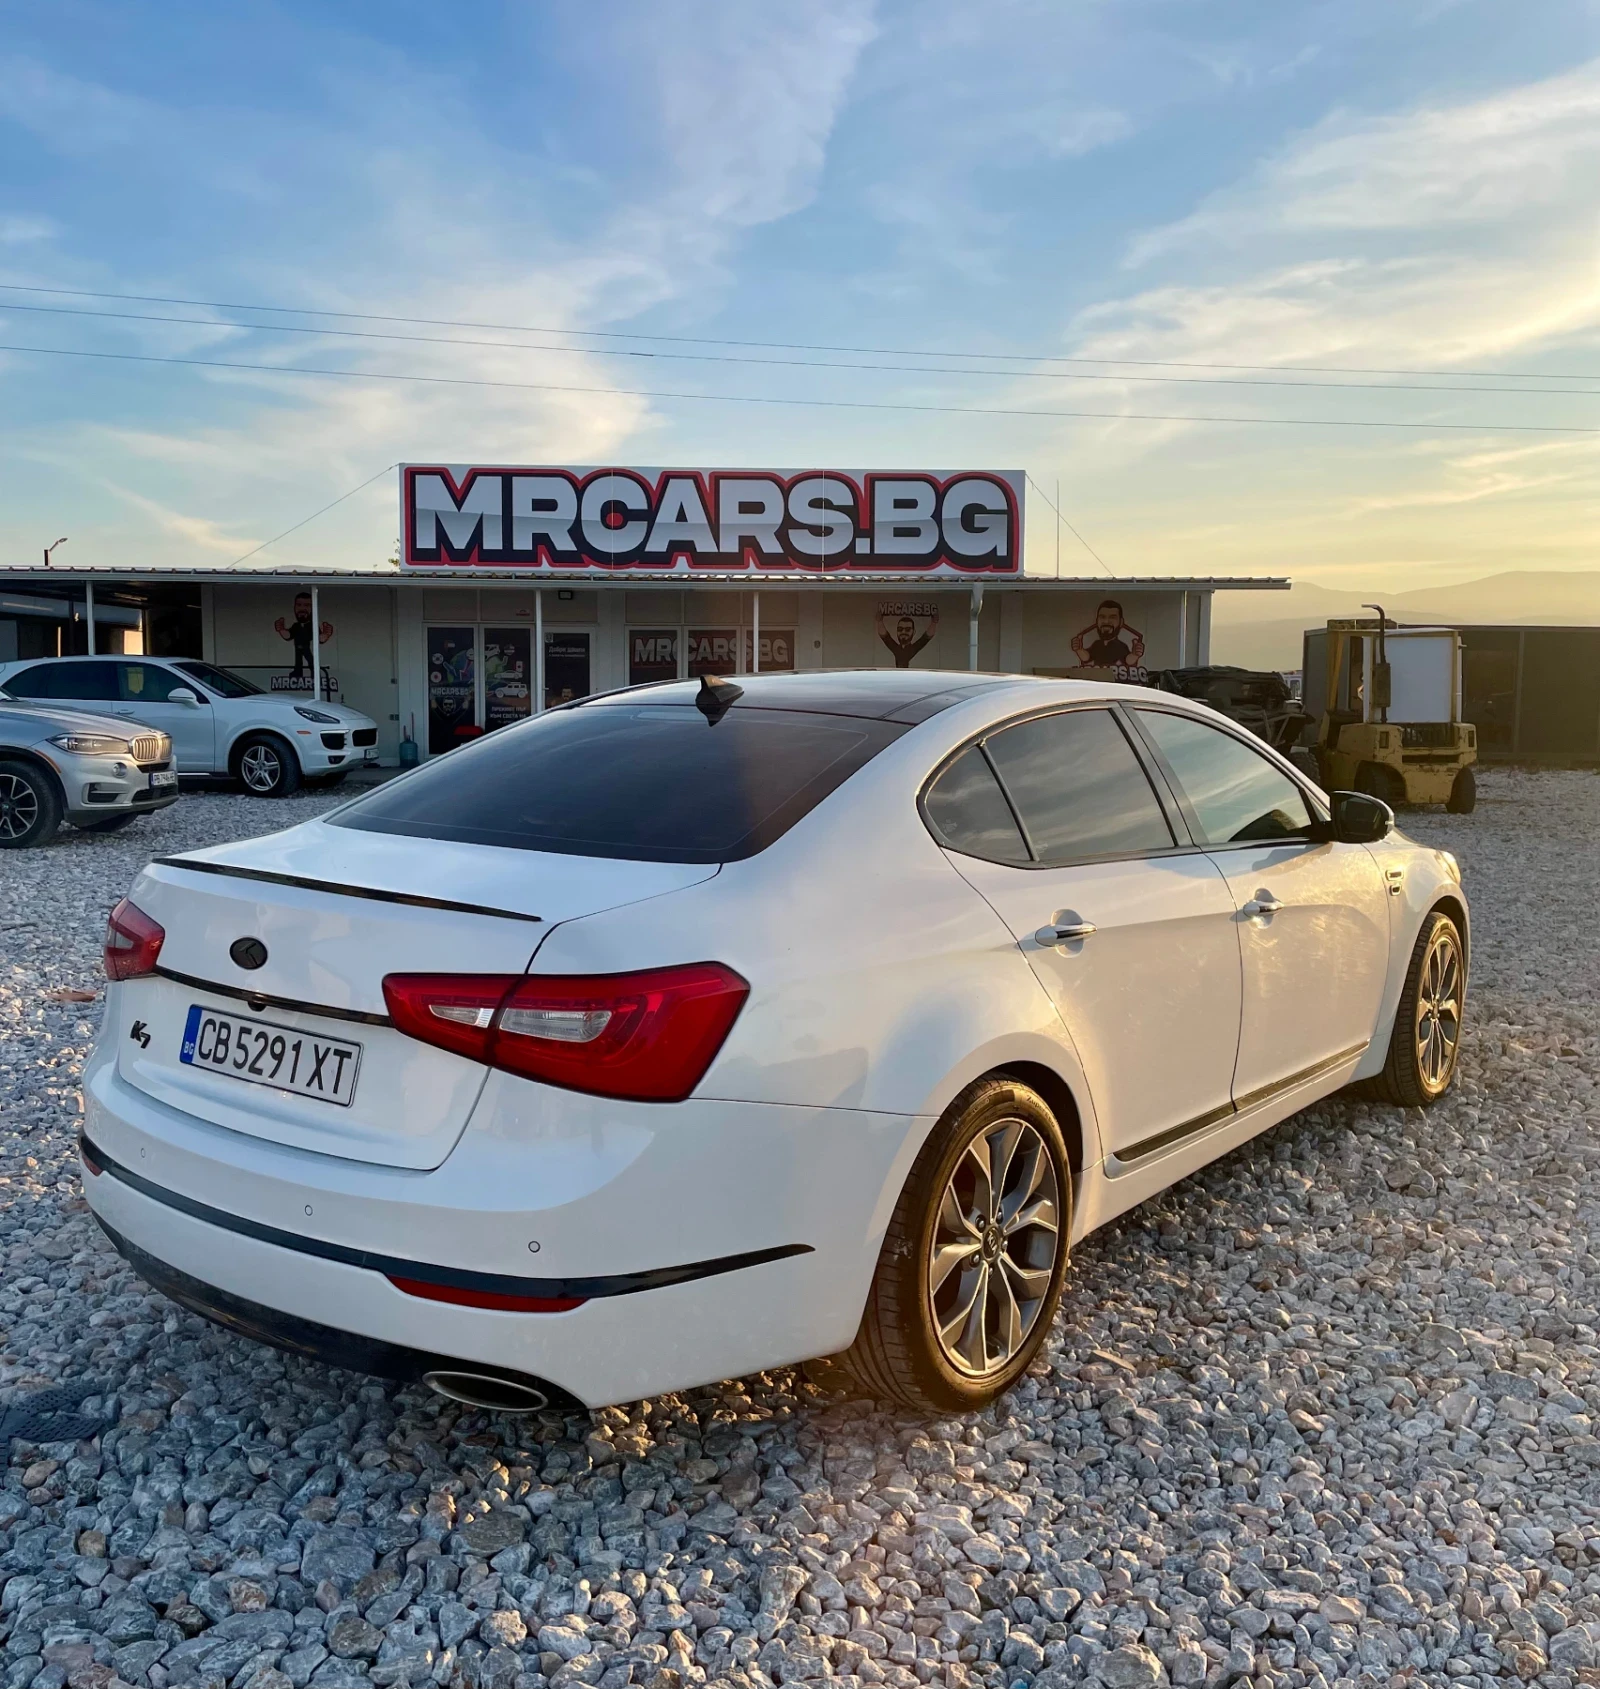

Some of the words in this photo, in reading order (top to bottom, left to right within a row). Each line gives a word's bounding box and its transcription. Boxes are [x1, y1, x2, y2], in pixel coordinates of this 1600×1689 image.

[413, 473, 1011, 560] MRCARS.BG
[634, 637, 789, 663] MRCARSBG
[183, 1041, 195, 1055] BG
